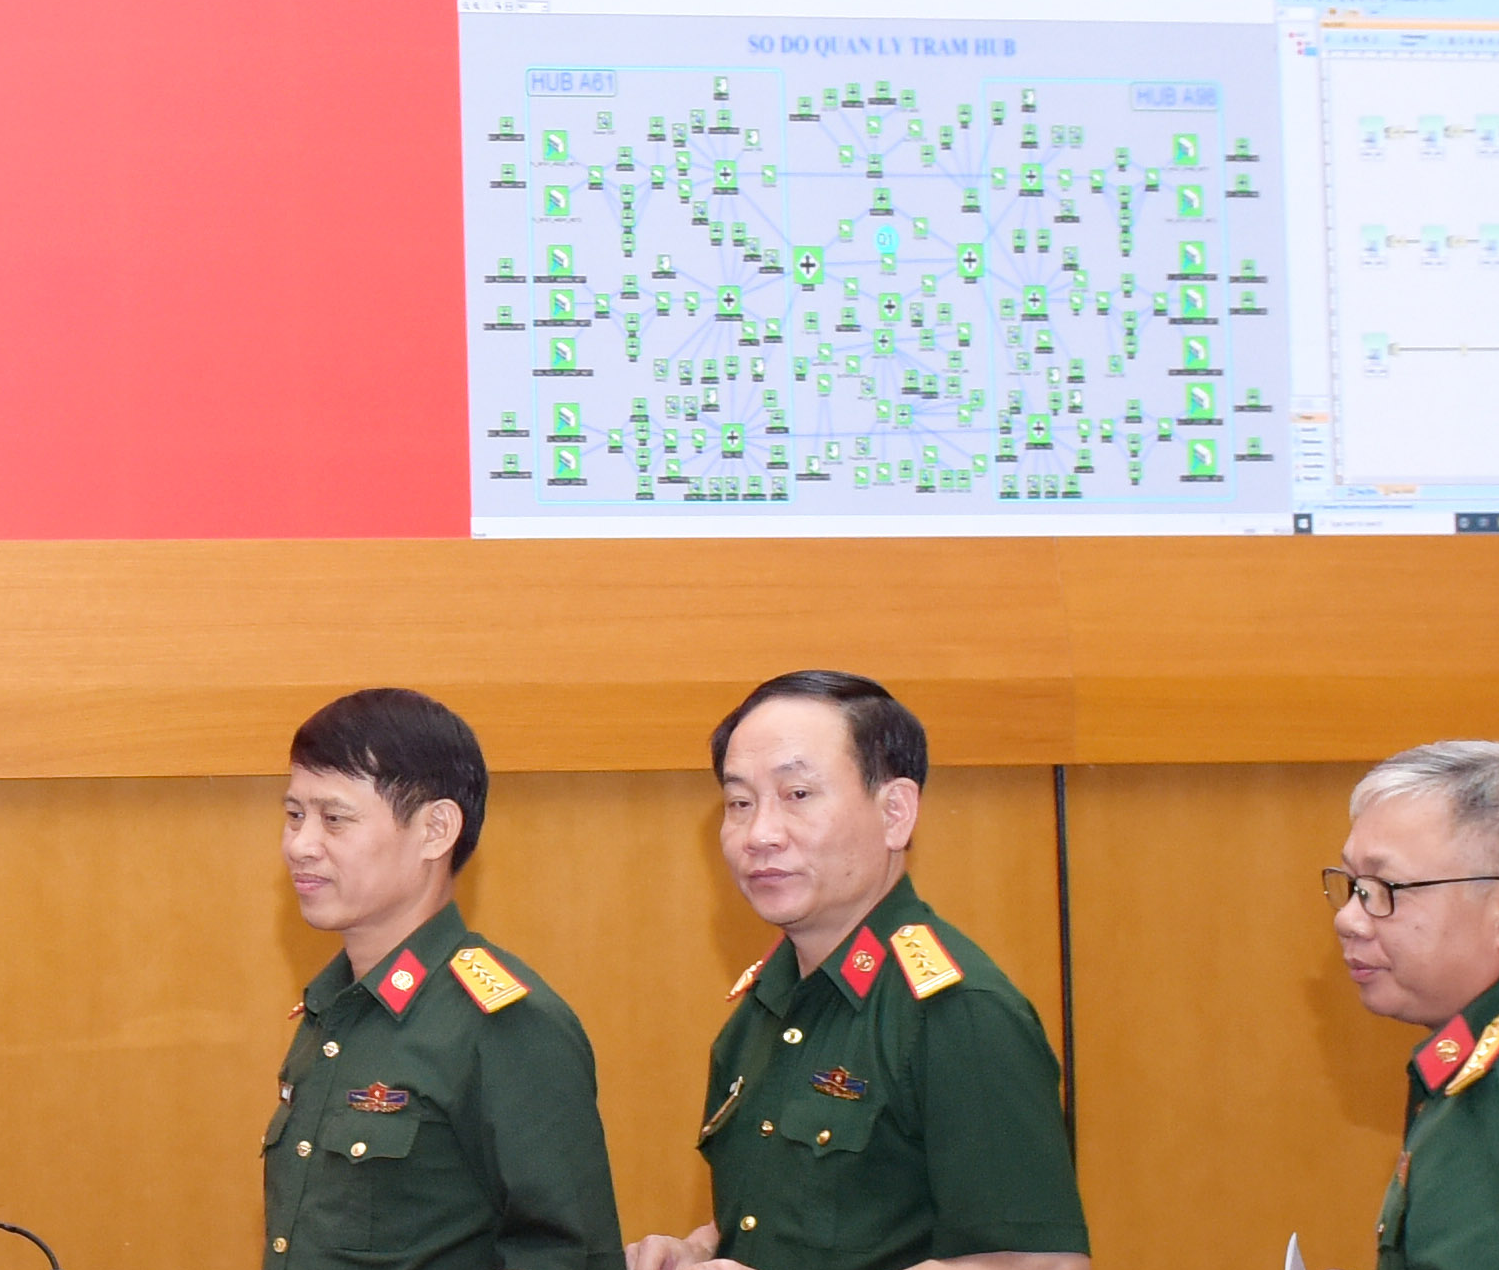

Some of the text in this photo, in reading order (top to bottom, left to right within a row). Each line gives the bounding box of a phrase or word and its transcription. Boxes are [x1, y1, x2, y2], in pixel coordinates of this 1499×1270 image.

[747, 35, 1017, 59] SO DO QUAN LY TRAM HUB
[532, 72, 614, 91] HUB A61
